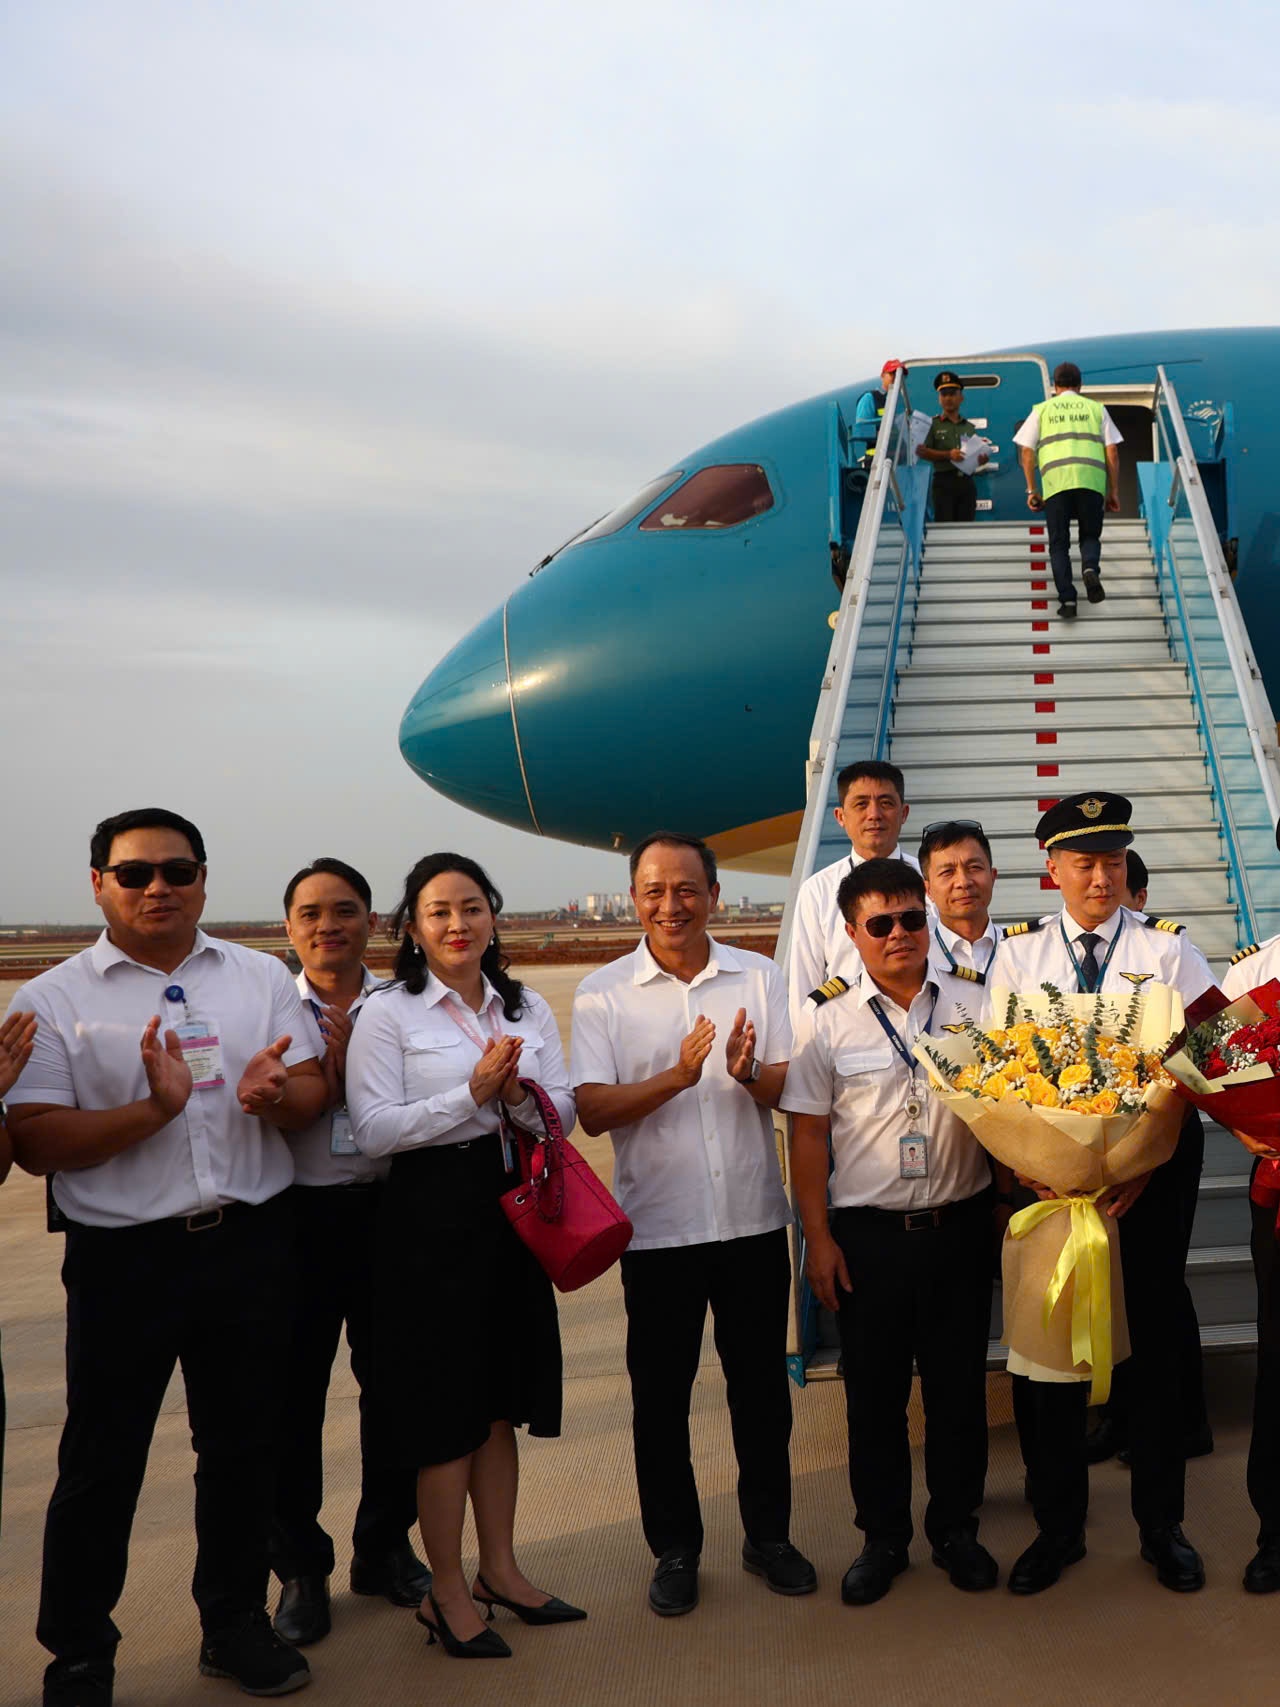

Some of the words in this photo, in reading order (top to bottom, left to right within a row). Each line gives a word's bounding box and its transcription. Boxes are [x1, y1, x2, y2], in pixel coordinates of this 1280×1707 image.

[1053, 402, 1084, 410] VAECO
[1049, 415, 1065, 424] HCM
[1069, 414, 1089, 422] RAMP
